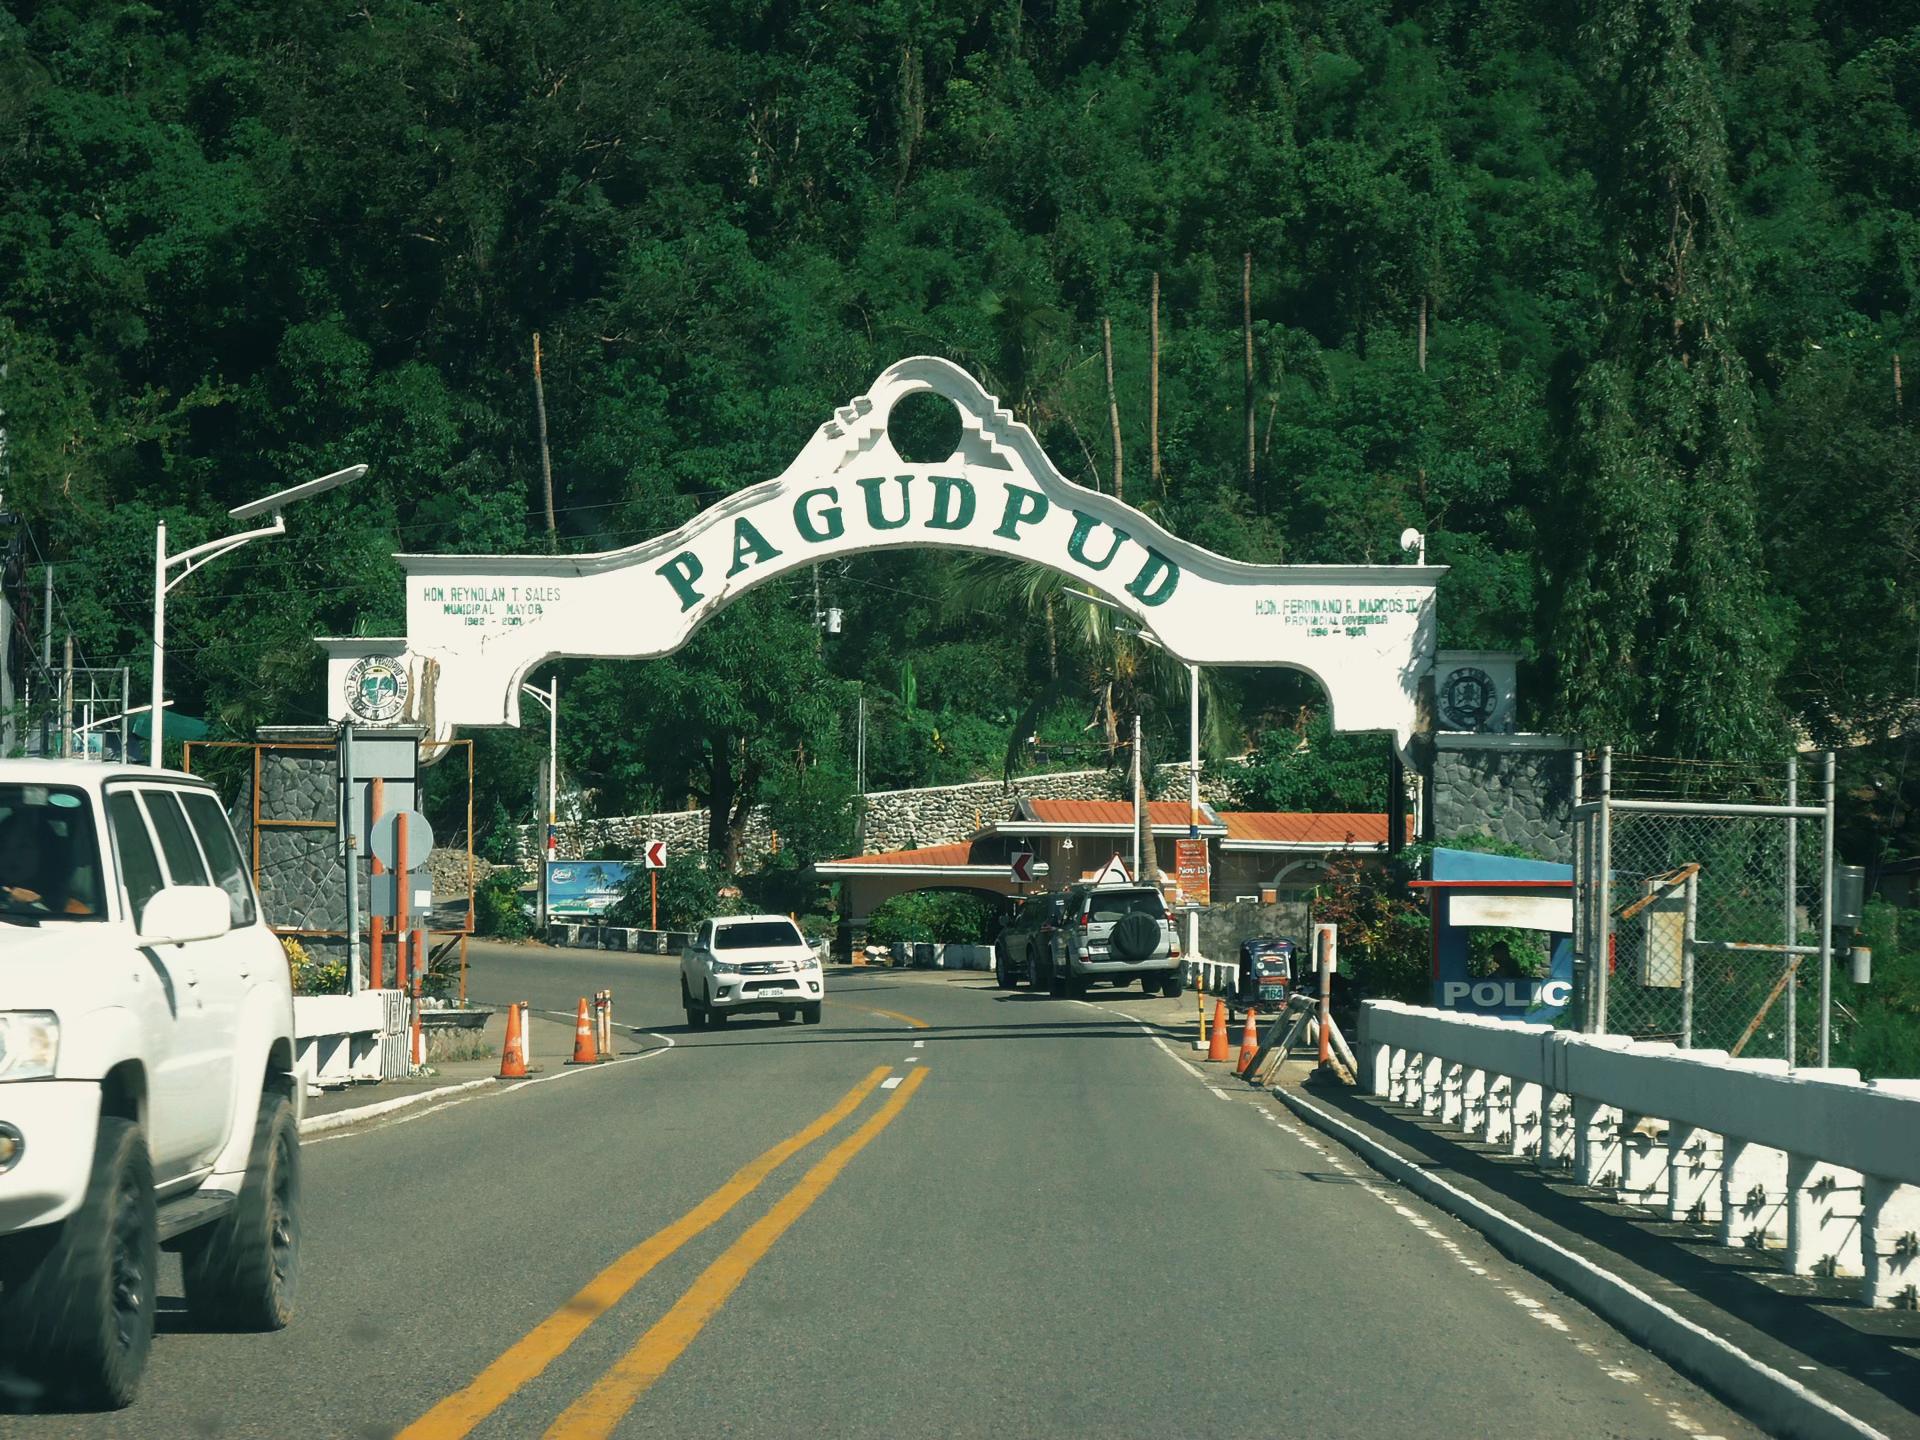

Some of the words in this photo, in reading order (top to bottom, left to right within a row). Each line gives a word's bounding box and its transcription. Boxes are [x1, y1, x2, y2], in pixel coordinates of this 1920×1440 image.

[655, 474, 1181, 613] PAGUDPUD
[451, 587, 505, 602] REYNOLAN
[525, 587, 561, 602] SALES
[443, 603, 495, 615] MUNICIPAL
[506, 603, 542, 615] MAYOR
[1283, 599, 1342, 615] FERDINAND
[1359, 598, 1404, 614] MARCOS
[1285, 615, 1339, 626] PROVINCIAL
[1341, 614, 1388, 625] GOVERNOR
[1443, 980, 1574, 1007] POLIC
